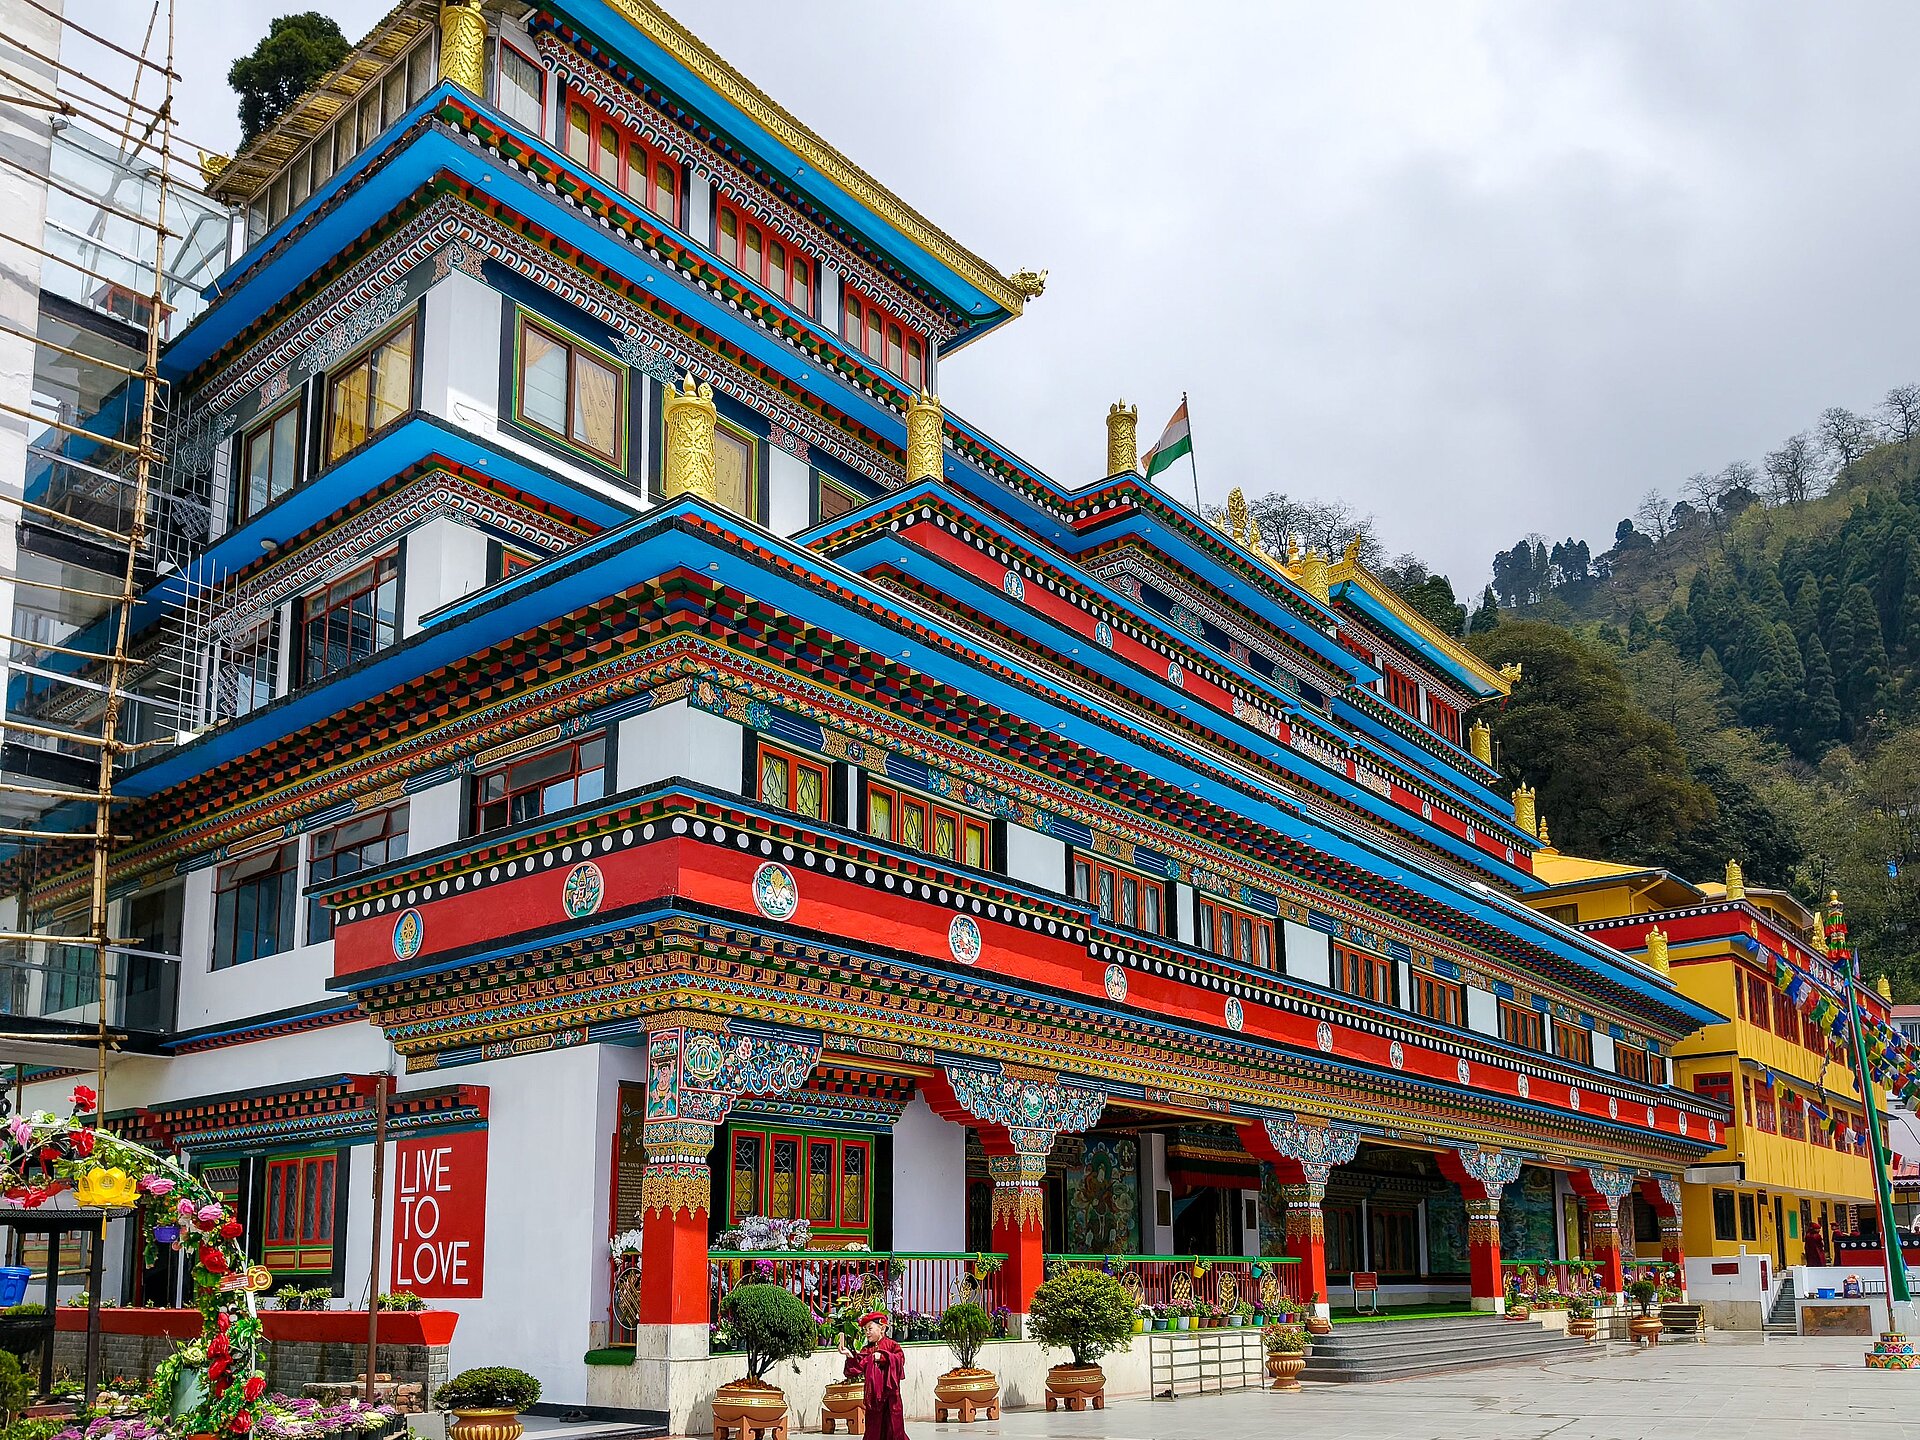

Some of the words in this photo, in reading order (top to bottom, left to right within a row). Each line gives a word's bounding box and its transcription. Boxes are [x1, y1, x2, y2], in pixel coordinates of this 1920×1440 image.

[401, 1147, 452, 1194] LIVE
[401, 1196, 440, 1240] TO
[397, 1241, 470, 1285] LOVE
